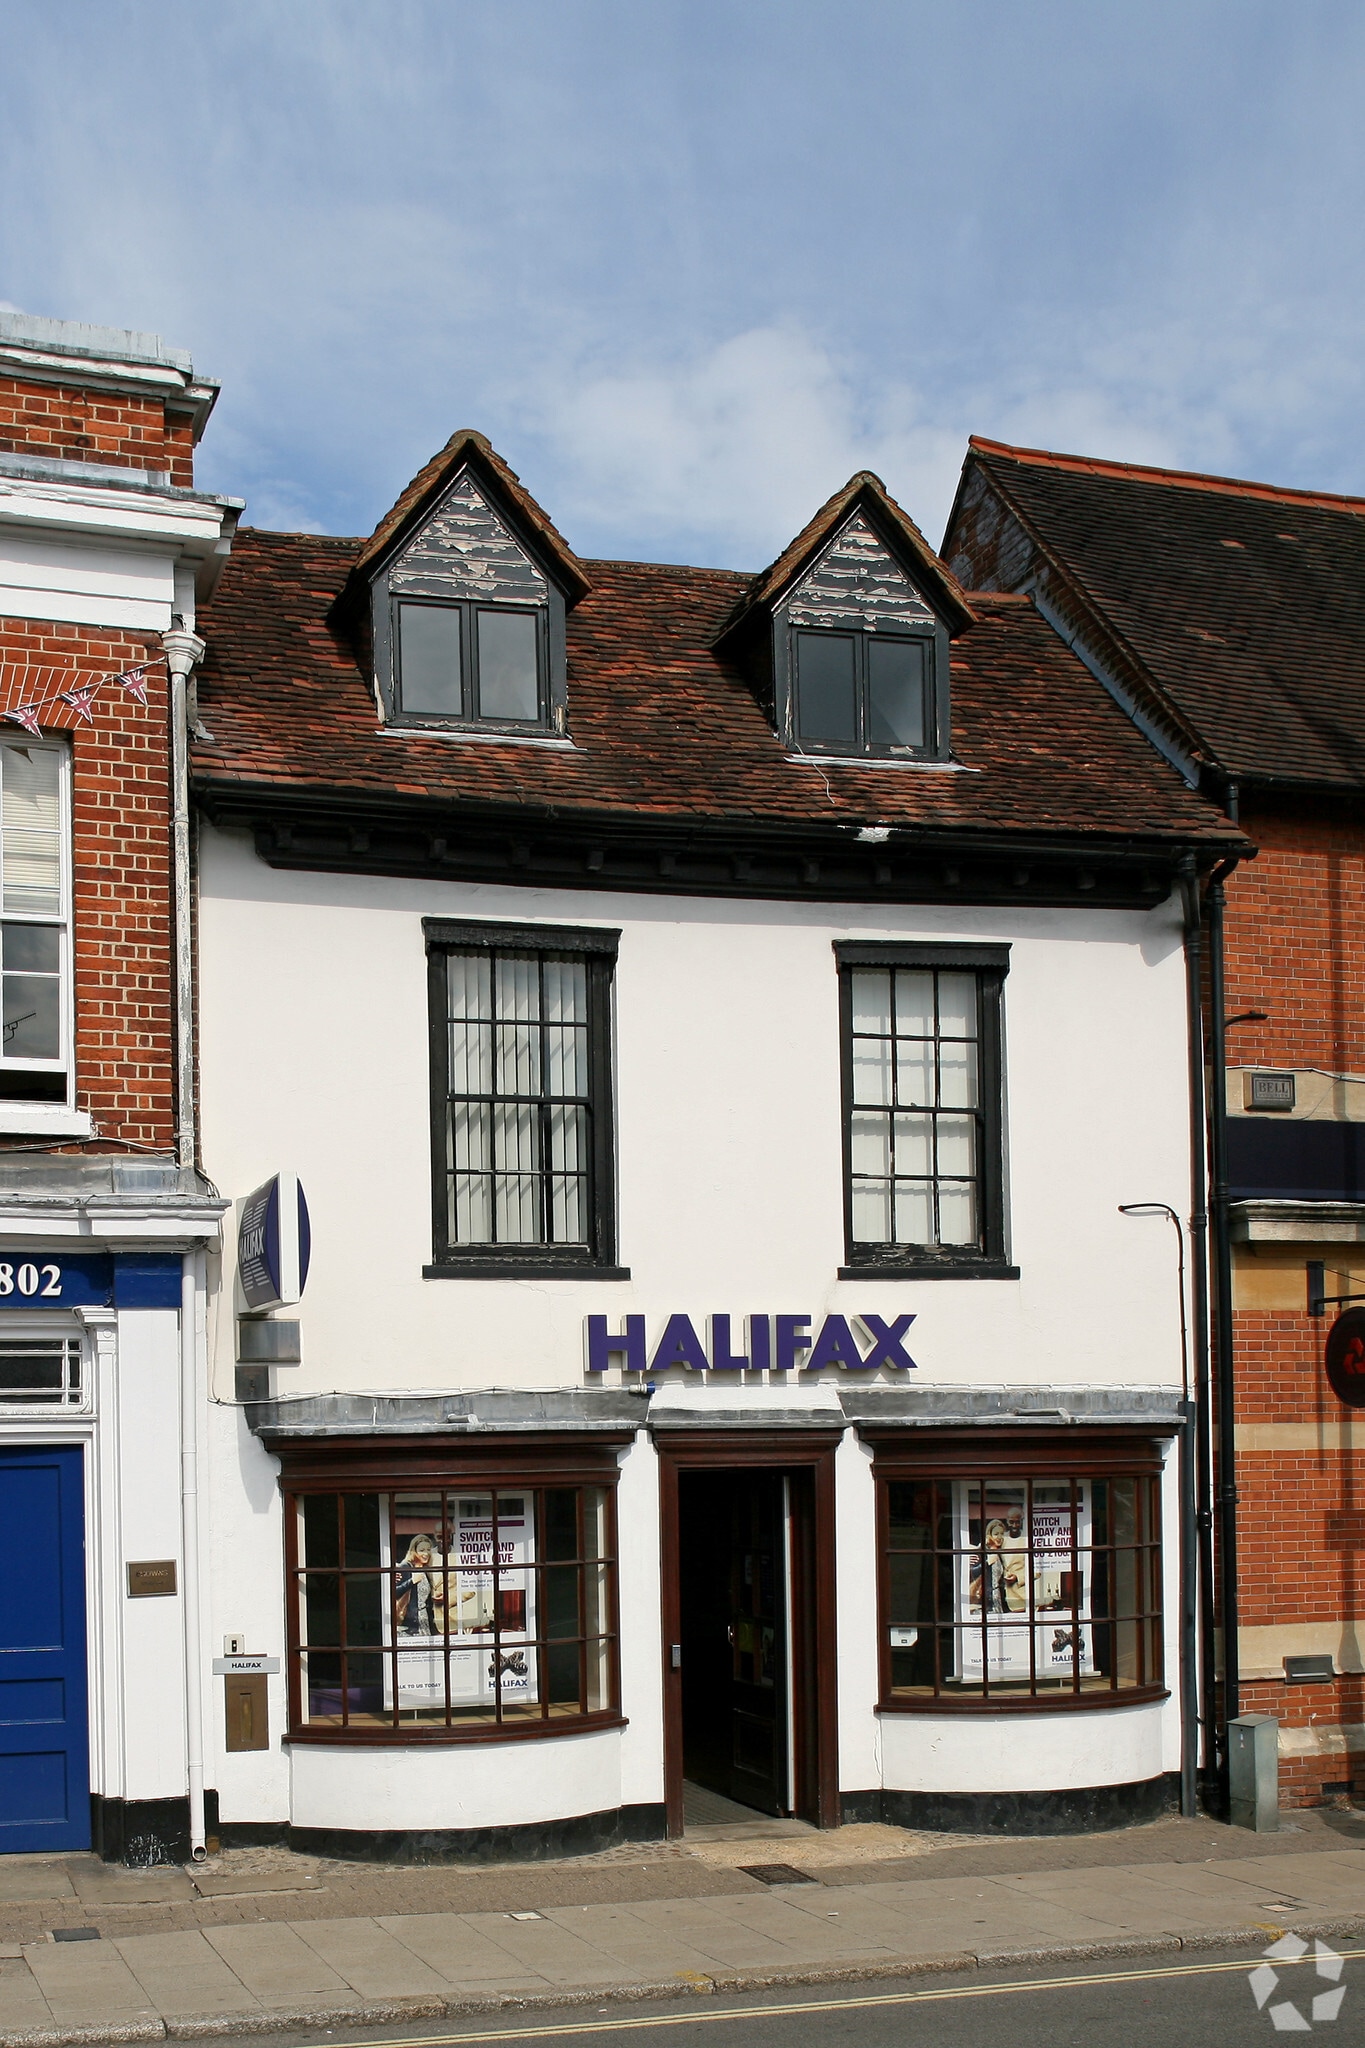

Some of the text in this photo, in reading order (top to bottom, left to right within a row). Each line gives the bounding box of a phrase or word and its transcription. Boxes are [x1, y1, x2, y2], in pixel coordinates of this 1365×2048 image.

[1259, 1081, 1289, 1094] BELL
[0, 1263, 63, 1297] 802
[583, 1313, 918, 1371] HALIFAX
[1033, 1517, 1060, 1526] WITCH
[1033, 1528, 1055, 1537] ODAY
[460, 1543, 491, 1553] TODAY
[460, 1554, 488, 1564] WE'LL
